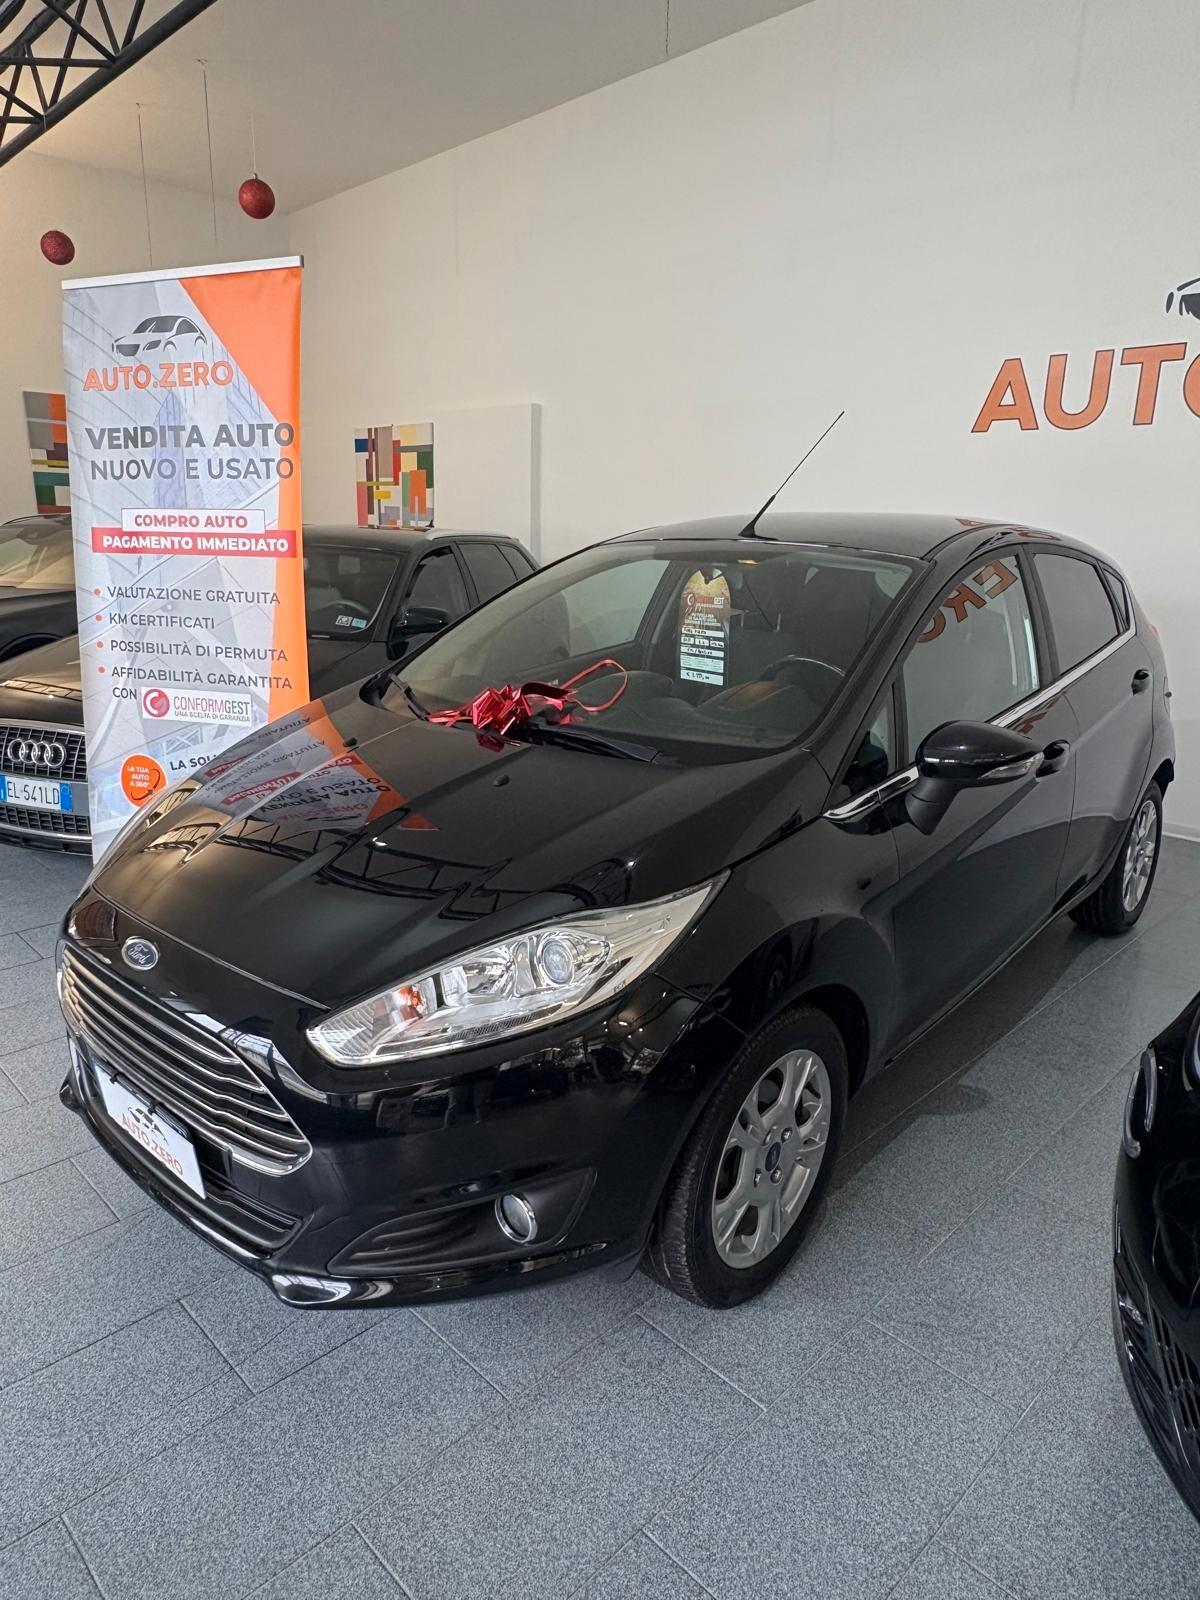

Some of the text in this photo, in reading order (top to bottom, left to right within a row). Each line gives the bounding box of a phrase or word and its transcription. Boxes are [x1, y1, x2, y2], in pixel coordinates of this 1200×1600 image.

[83, 360, 234, 391] AUTO.ZERO
[971, 342, 1200, 433] AUT
[85, 422, 295, 450] VENDITA AUTO
[91, 457, 294, 481] NUOVO E USATO
[134, 514, 248, 529] COMPRO AUTO
[102, 535, 289, 552] PAGAMENTO IMMEDIATO
[107, 586, 281, 604] VALUTAZIONE GRATUITA
[109, 613, 215, 629] KM CERTIFICATI
[110, 640, 288, 662] POSSIBILITÀ DI PERMUTA
[111, 666, 293, 690] AFFIDABILITÀ GARANTITA
[112, 687, 137, 700] CON
[173, 696, 250, 716] CONFORMGEST
[170, 760, 187, 771] LA
[7, 781, 60, 805] EL 541LD
[128, 943, 151, 964] Ford
[121, 1113, 184, 1177] AUTO.ZERO
